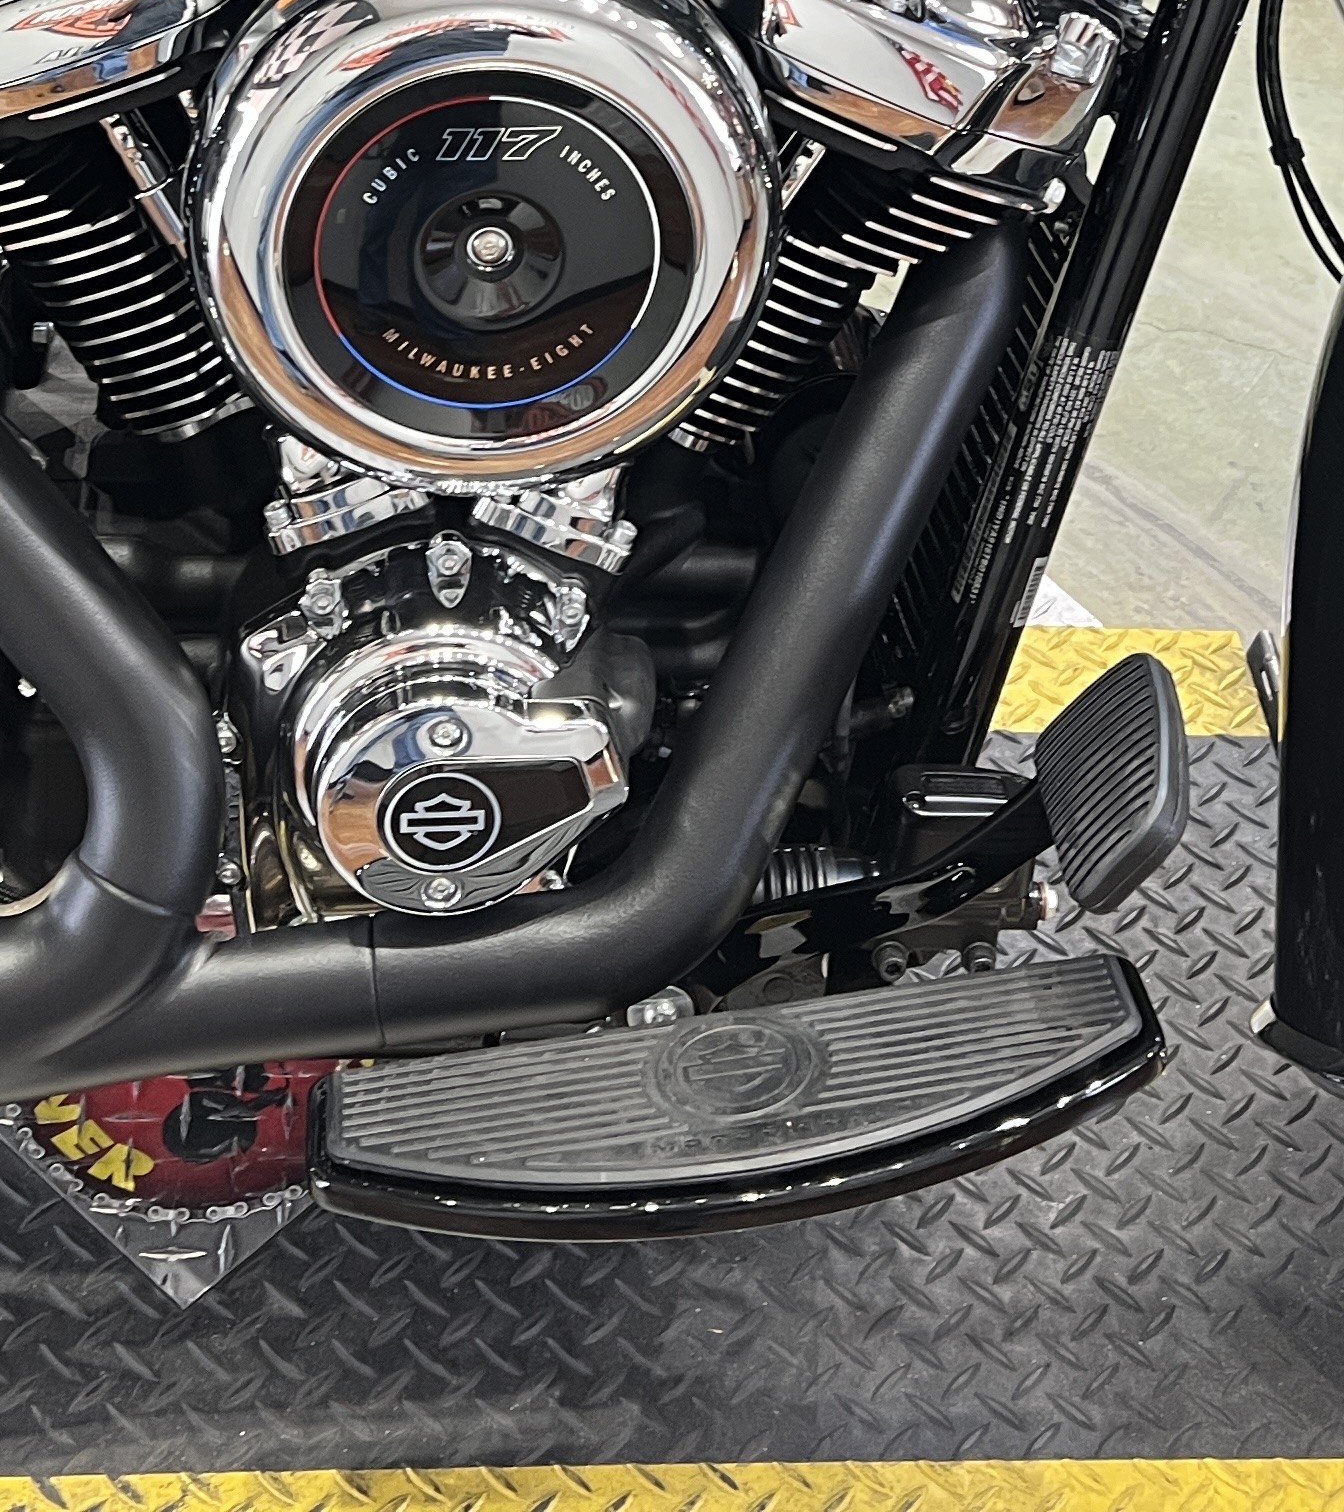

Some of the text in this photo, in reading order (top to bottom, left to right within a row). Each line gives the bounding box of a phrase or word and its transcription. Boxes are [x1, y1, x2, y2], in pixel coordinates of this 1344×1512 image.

[361, 125, 617, 206] CUBIC 117 INCHES
[381, 322, 596, 381] MILWAUKEE-EIGHT
